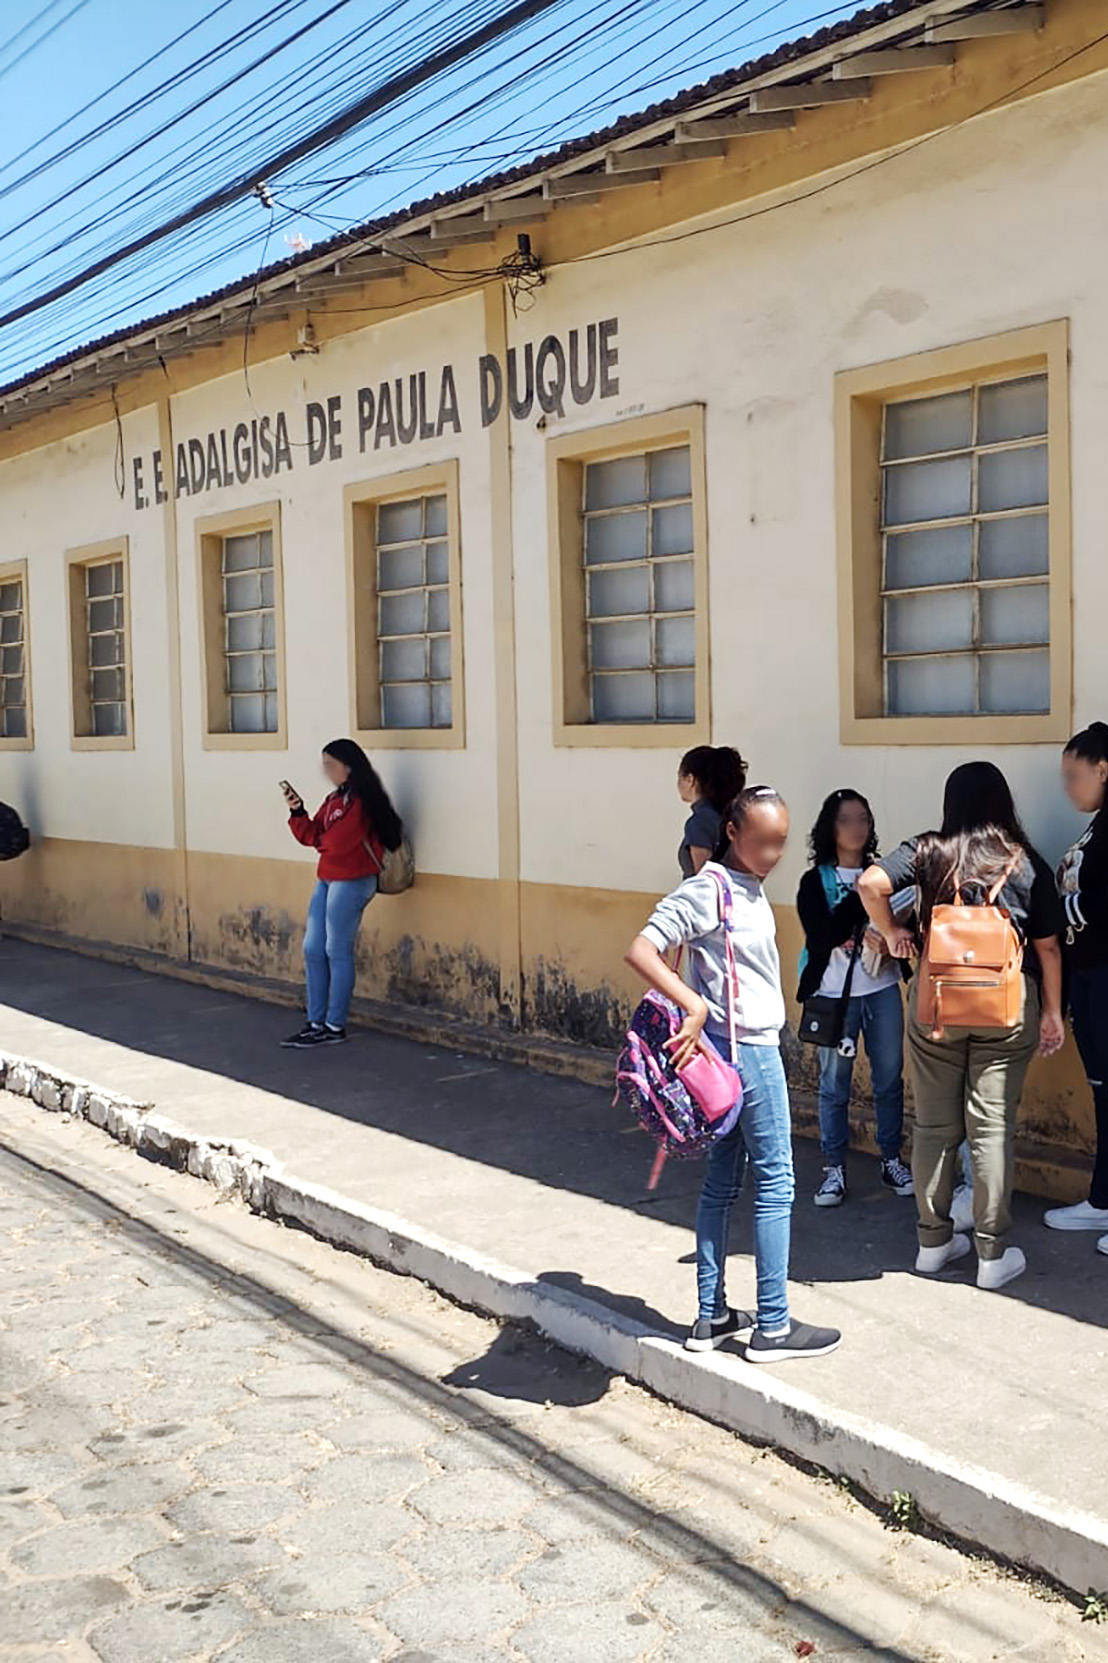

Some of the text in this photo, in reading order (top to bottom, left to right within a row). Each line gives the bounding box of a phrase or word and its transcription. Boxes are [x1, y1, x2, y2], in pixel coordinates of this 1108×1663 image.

[175, 410, 293, 499] ADALGISA
[306, 395, 343, 466] DE
[357, 365, 461, 454] PAULA
[479, 317, 620, 428] DUQUE
